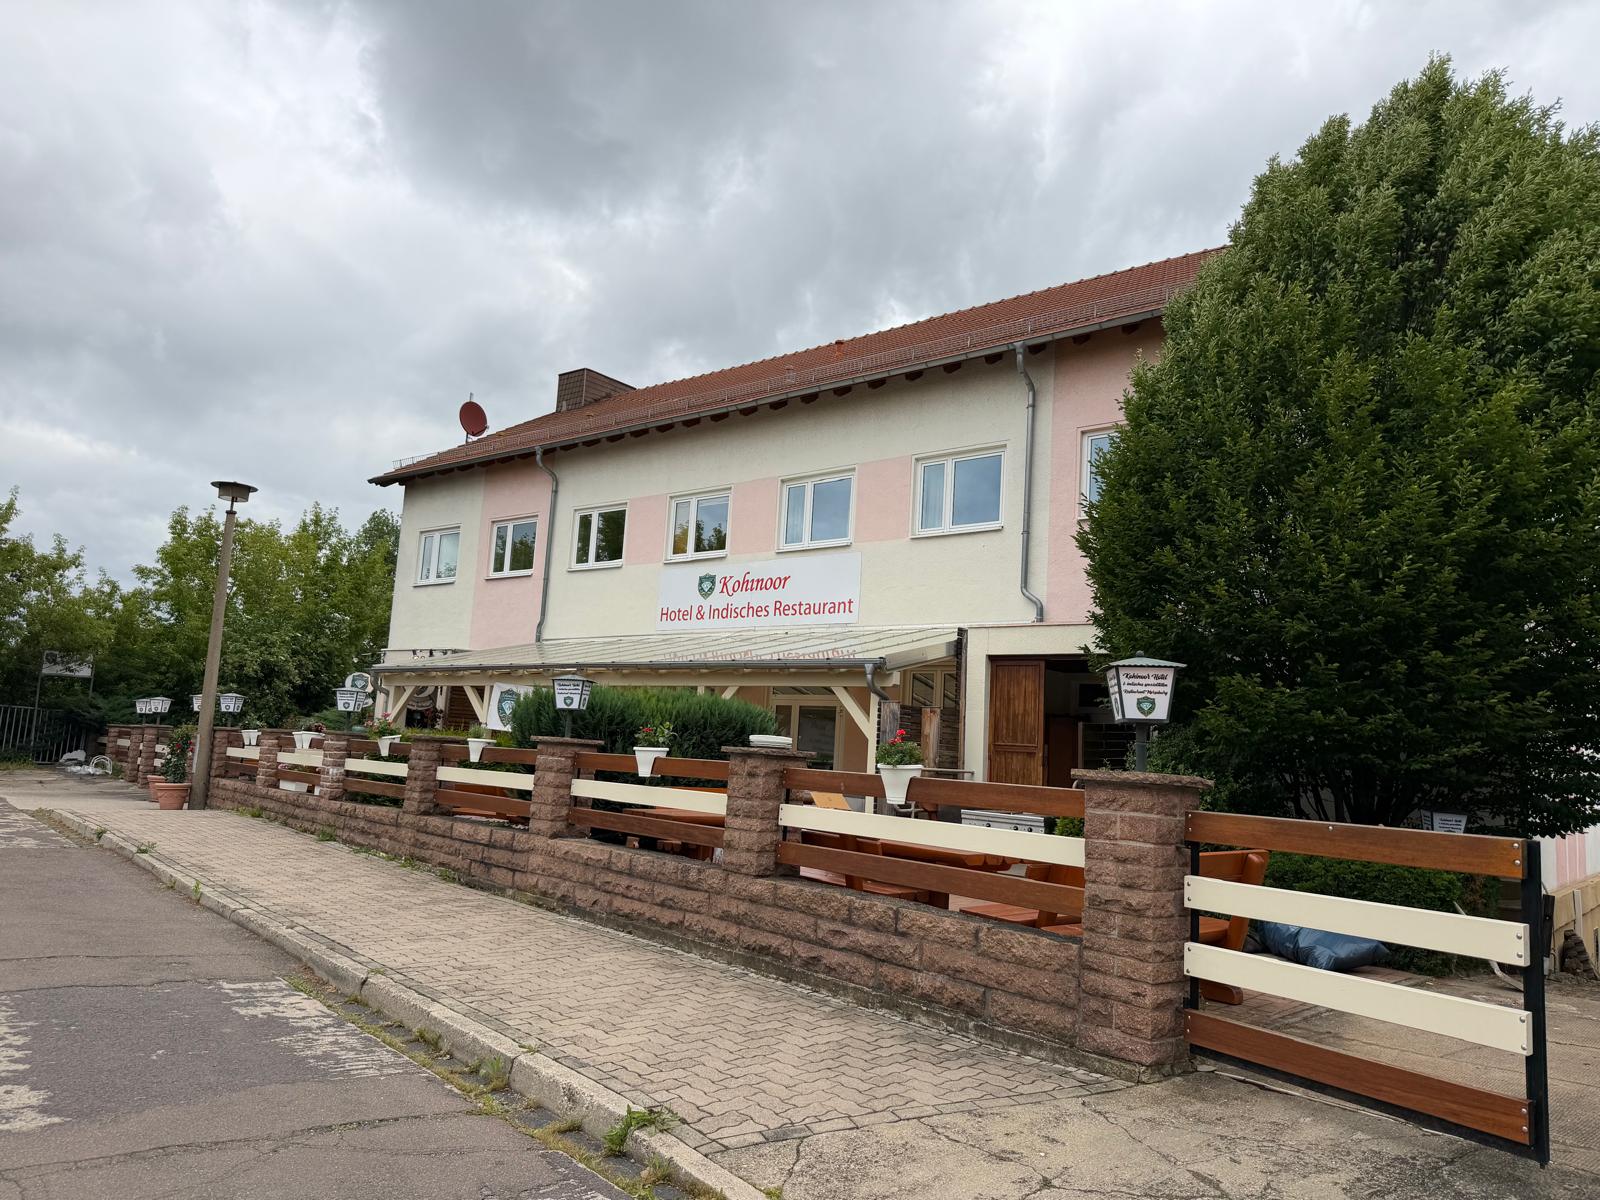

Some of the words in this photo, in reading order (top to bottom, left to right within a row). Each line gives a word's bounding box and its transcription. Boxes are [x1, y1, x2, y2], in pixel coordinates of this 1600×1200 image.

[719, 572, 791, 597] Kohinoor
[660, 605, 693, 622] Hotel
[695, 604, 705, 620] &
[708, 602, 770, 620] Indisches
[773, 598, 854, 617] Restaurant
